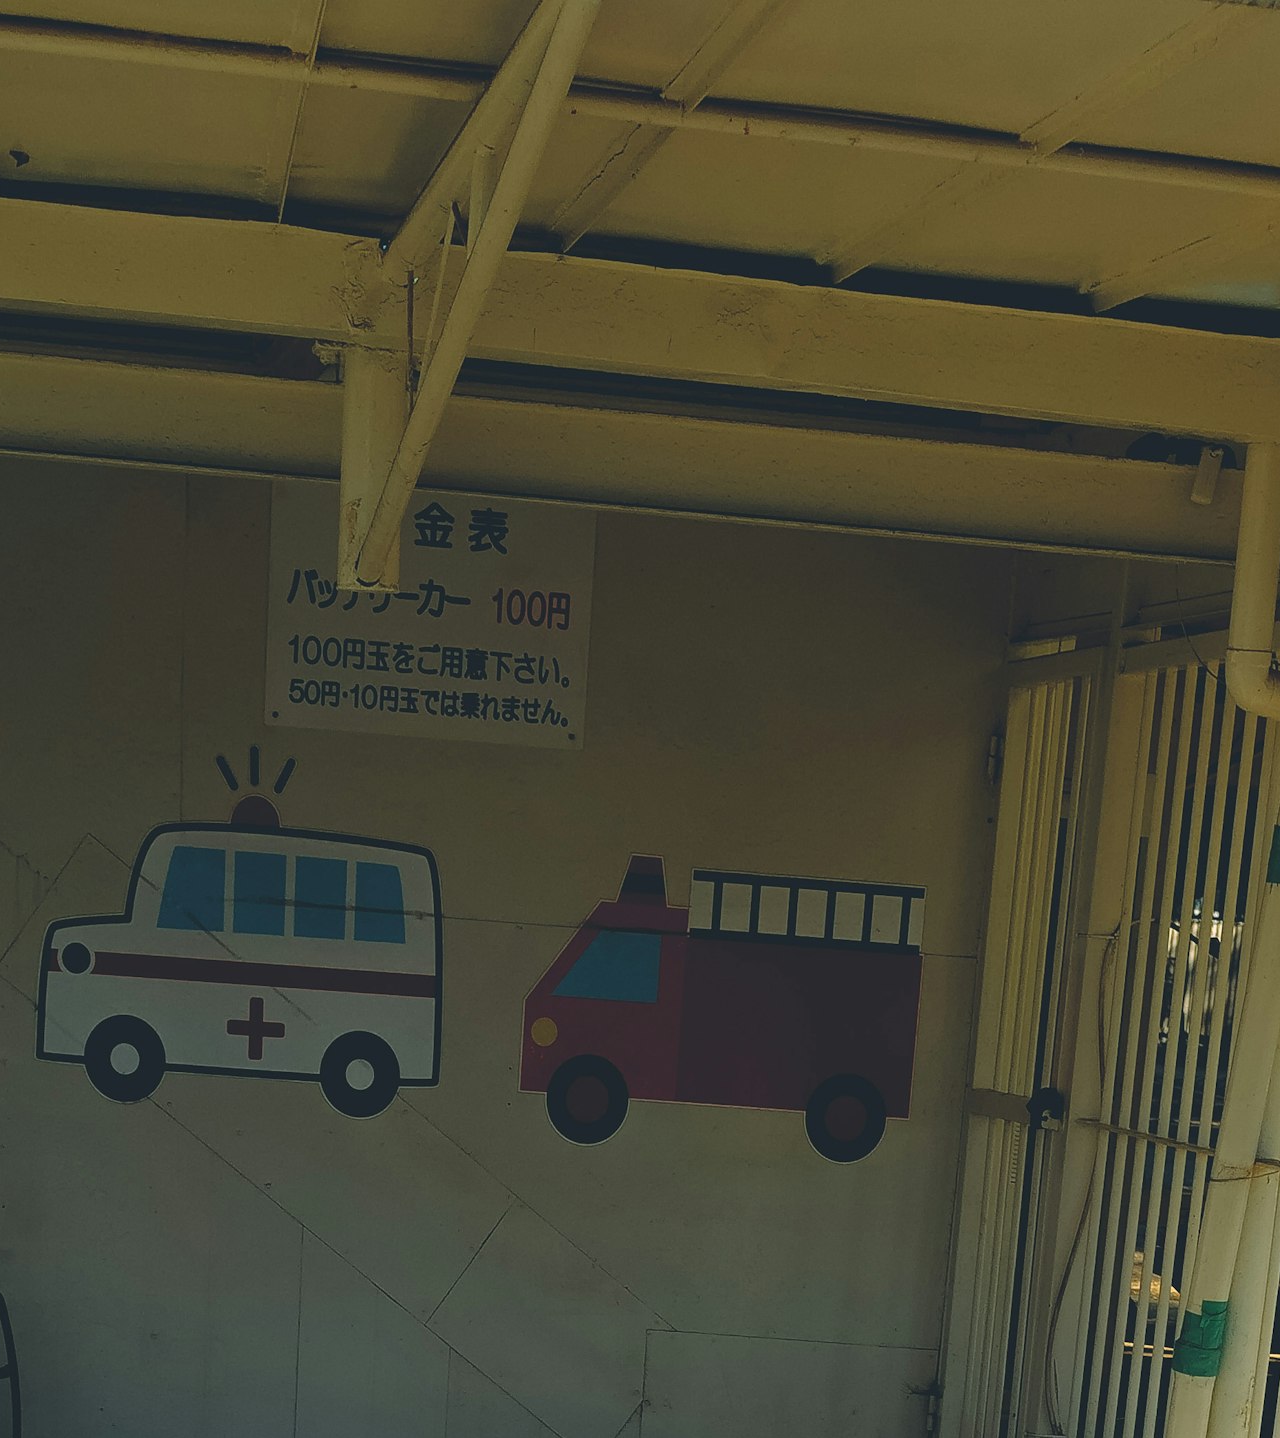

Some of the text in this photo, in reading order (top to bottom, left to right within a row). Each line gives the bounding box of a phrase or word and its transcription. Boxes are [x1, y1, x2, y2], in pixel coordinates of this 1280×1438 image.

[287, 569, 571, 631] バッリーカー 100円
[288, 634, 570, 688] 100円玉をご用意下さい。
[288, 679, 569, 728] 50円・10円玉では乗れません。
